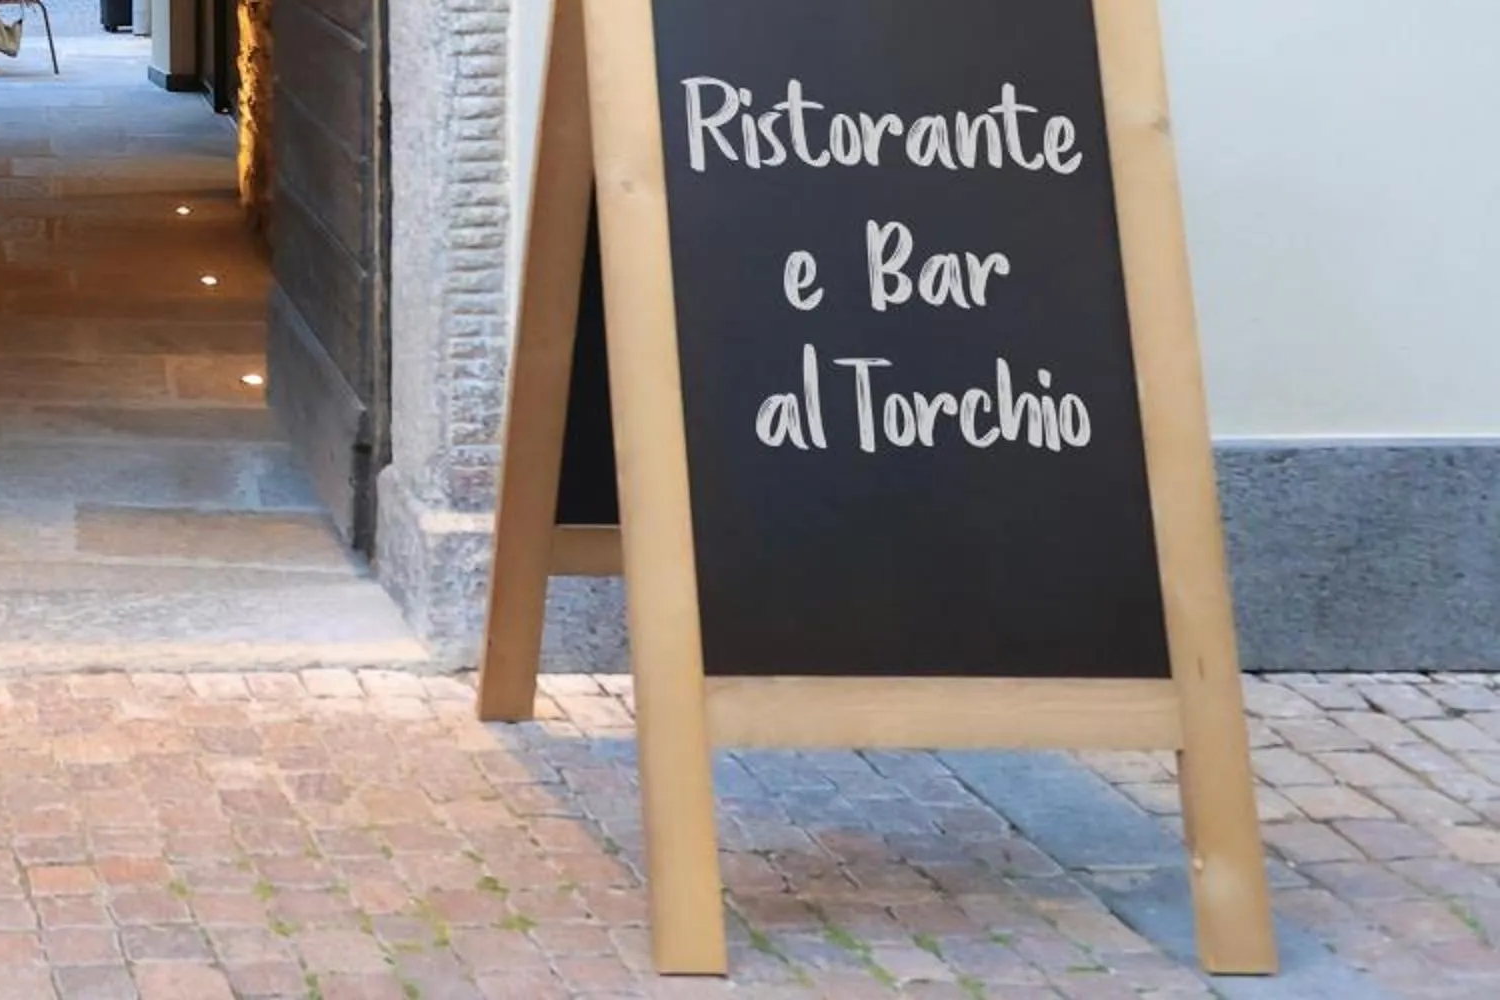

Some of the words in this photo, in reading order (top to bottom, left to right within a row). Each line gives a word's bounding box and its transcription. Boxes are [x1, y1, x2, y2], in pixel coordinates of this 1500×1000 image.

[681, 75, 1083, 174] Ristorante
[783, 249, 824, 311] e
[866, 219, 1011, 312] Bar
[755, 343, 828, 450] al
[833, 358, 1092, 453] Torchio
